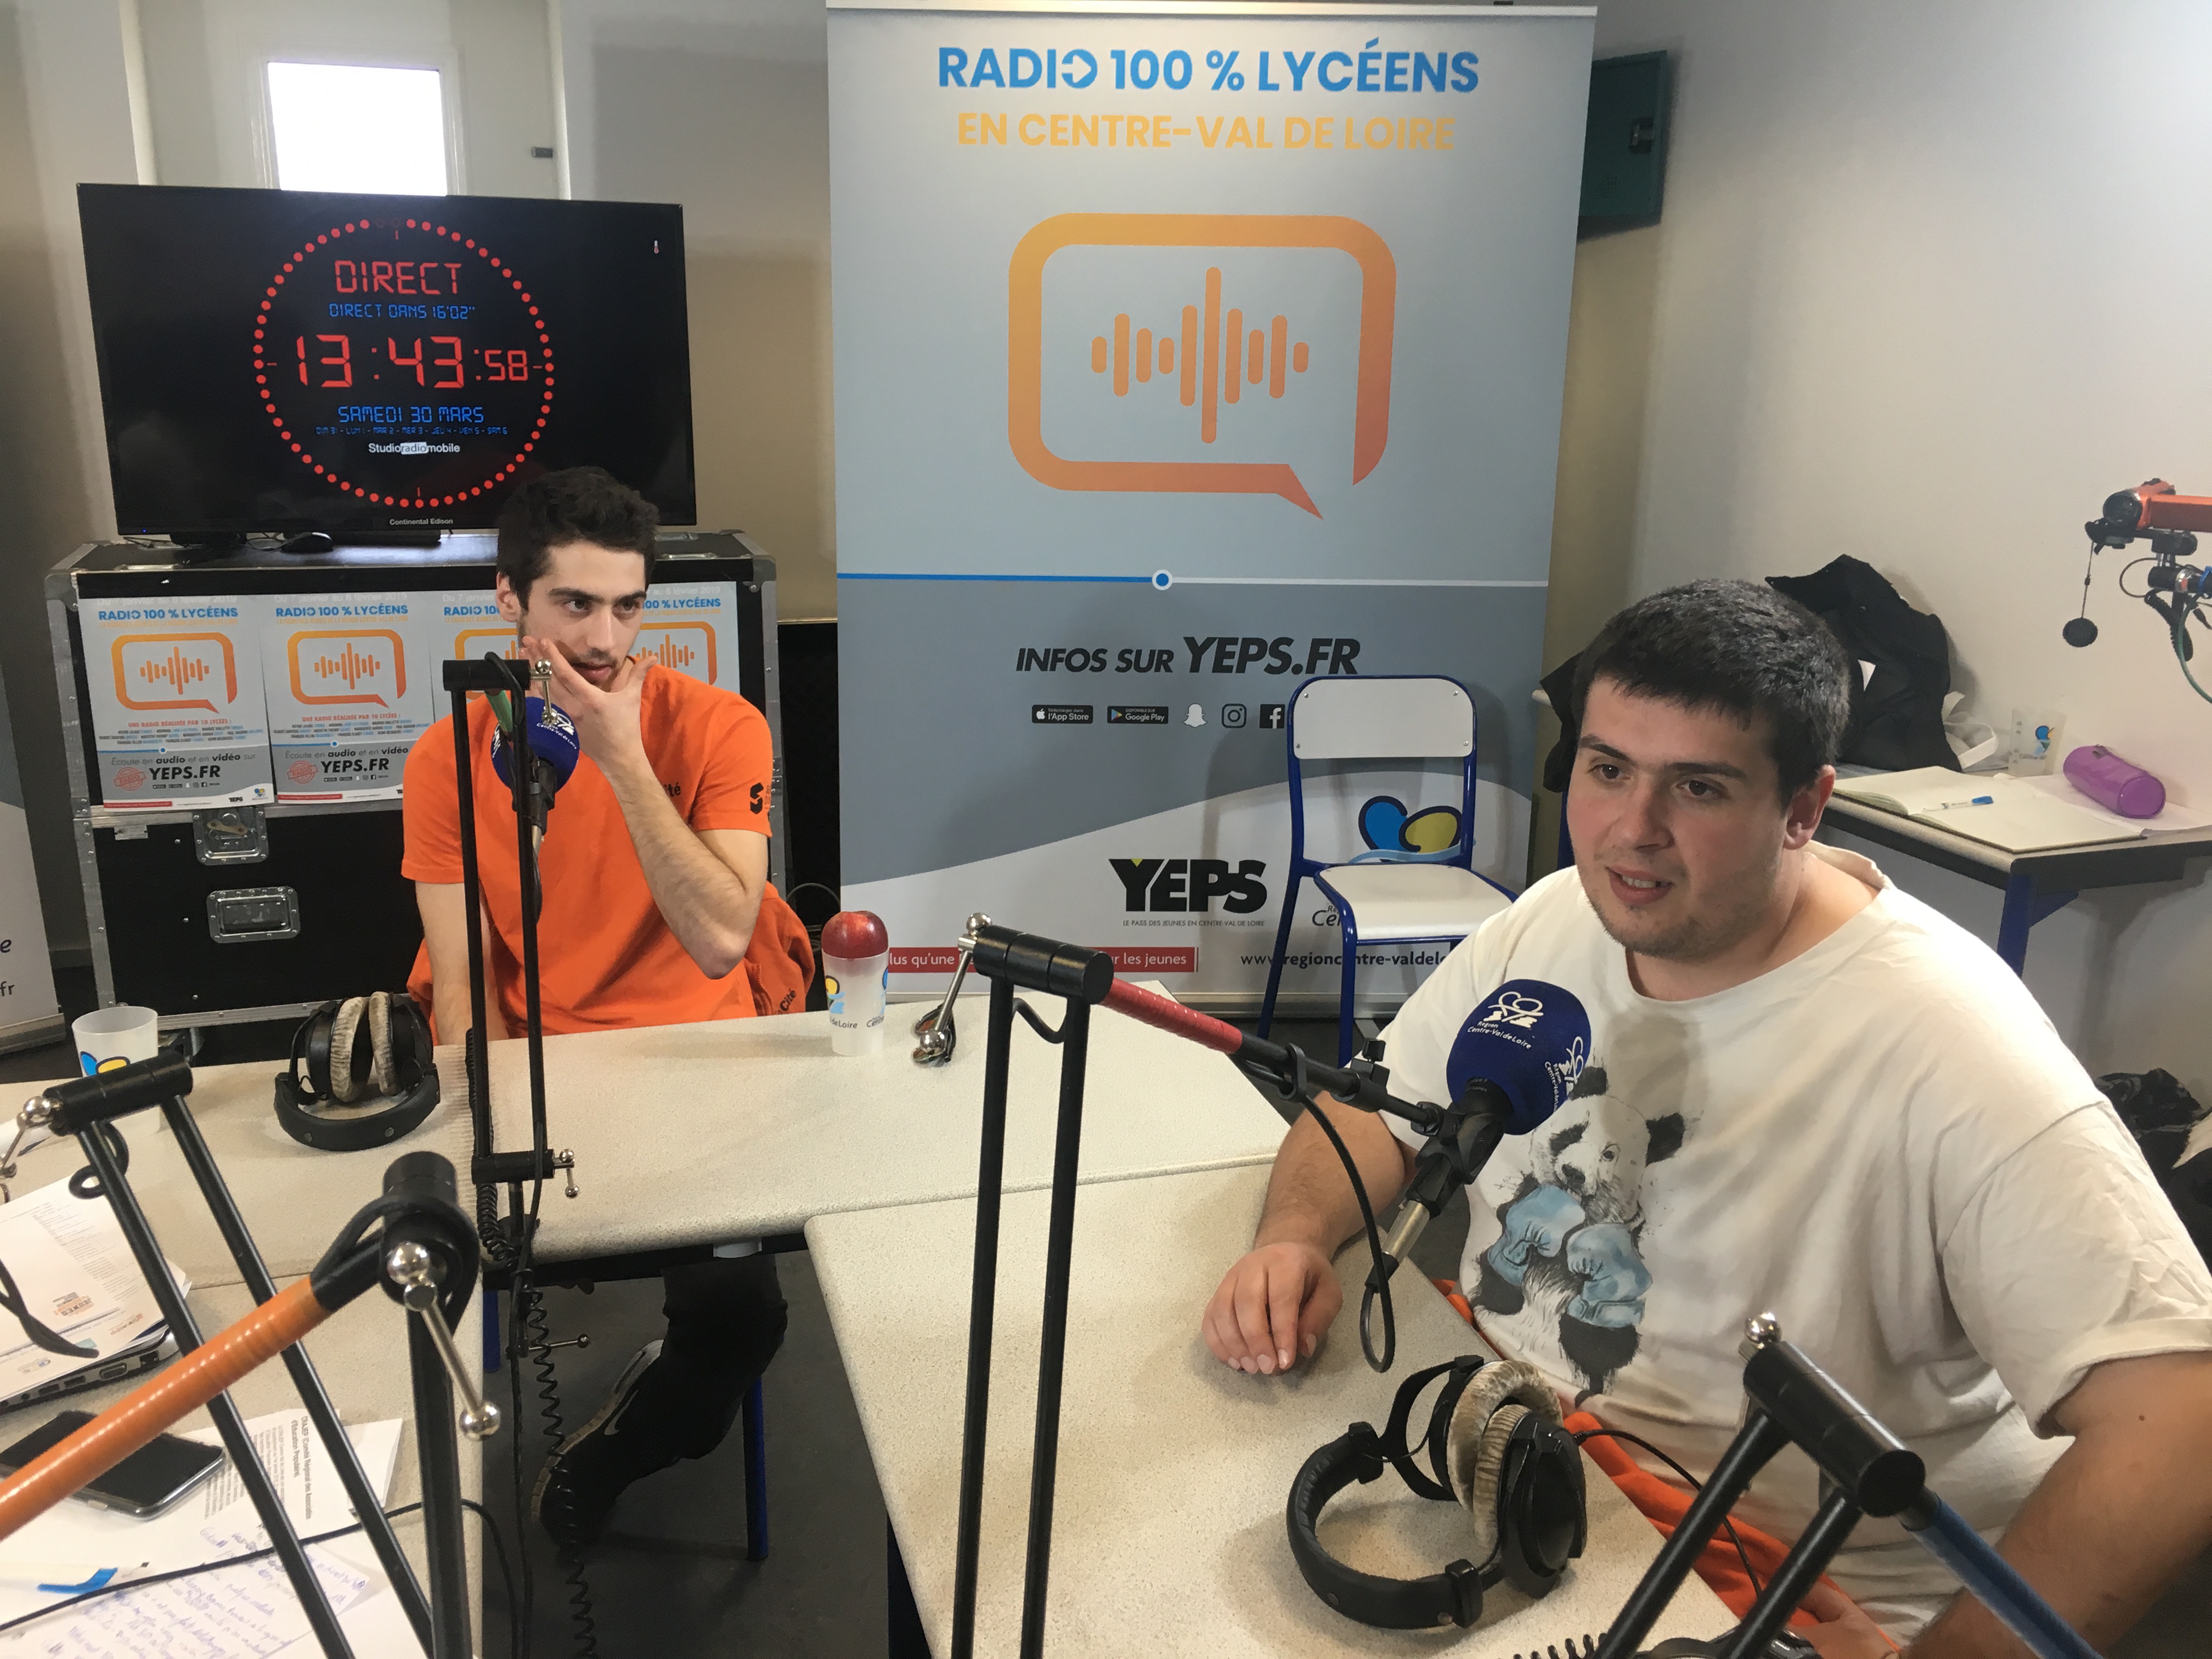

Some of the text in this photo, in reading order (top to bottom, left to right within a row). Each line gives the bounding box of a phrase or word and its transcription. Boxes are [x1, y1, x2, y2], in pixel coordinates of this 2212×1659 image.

[939, 37, 1479, 94] RADIO 100 % LYCÉENS
[958, 113, 1455, 150] EN CENTRE-VAL DE LOIRE
[335, 260, 461, 295] DIRECT
[329, 303, 381, 317] DIRECT
[338, 407, 483, 422] SAMEDI 30 MARS
[662, 600, 672, 608] %
[673, 596, 721, 608] LYCÉENS
[99, 606, 238, 620] RADIO 100 % LYCÉENS
[276, 603, 408, 617] RADIO 100 % LYCÉENS
[444, 606, 482, 616] RADIO
[1016, 637, 1360, 675] INFOS SUR YEPS.FR
[1048, 713, 1067, 721] l'App
[1125, 714, 1150, 722] Google
[111, 757, 139, 766] Écoute
[156, 756, 185, 764] audio
[212, 753, 240, 761] vidéo
[285, 751, 312, 759] Écoute
[381, 747, 410, 755] vidéo
[321, 757, 389, 773] YEPS.FR
[149, 765, 220, 780] YEPS.FR
[1108, 858, 1267, 914] YEPS
[889, 953, 907, 964] lus
[1124, 952, 1141, 964] les
[1144, 953, 1187, 968] jeunes
